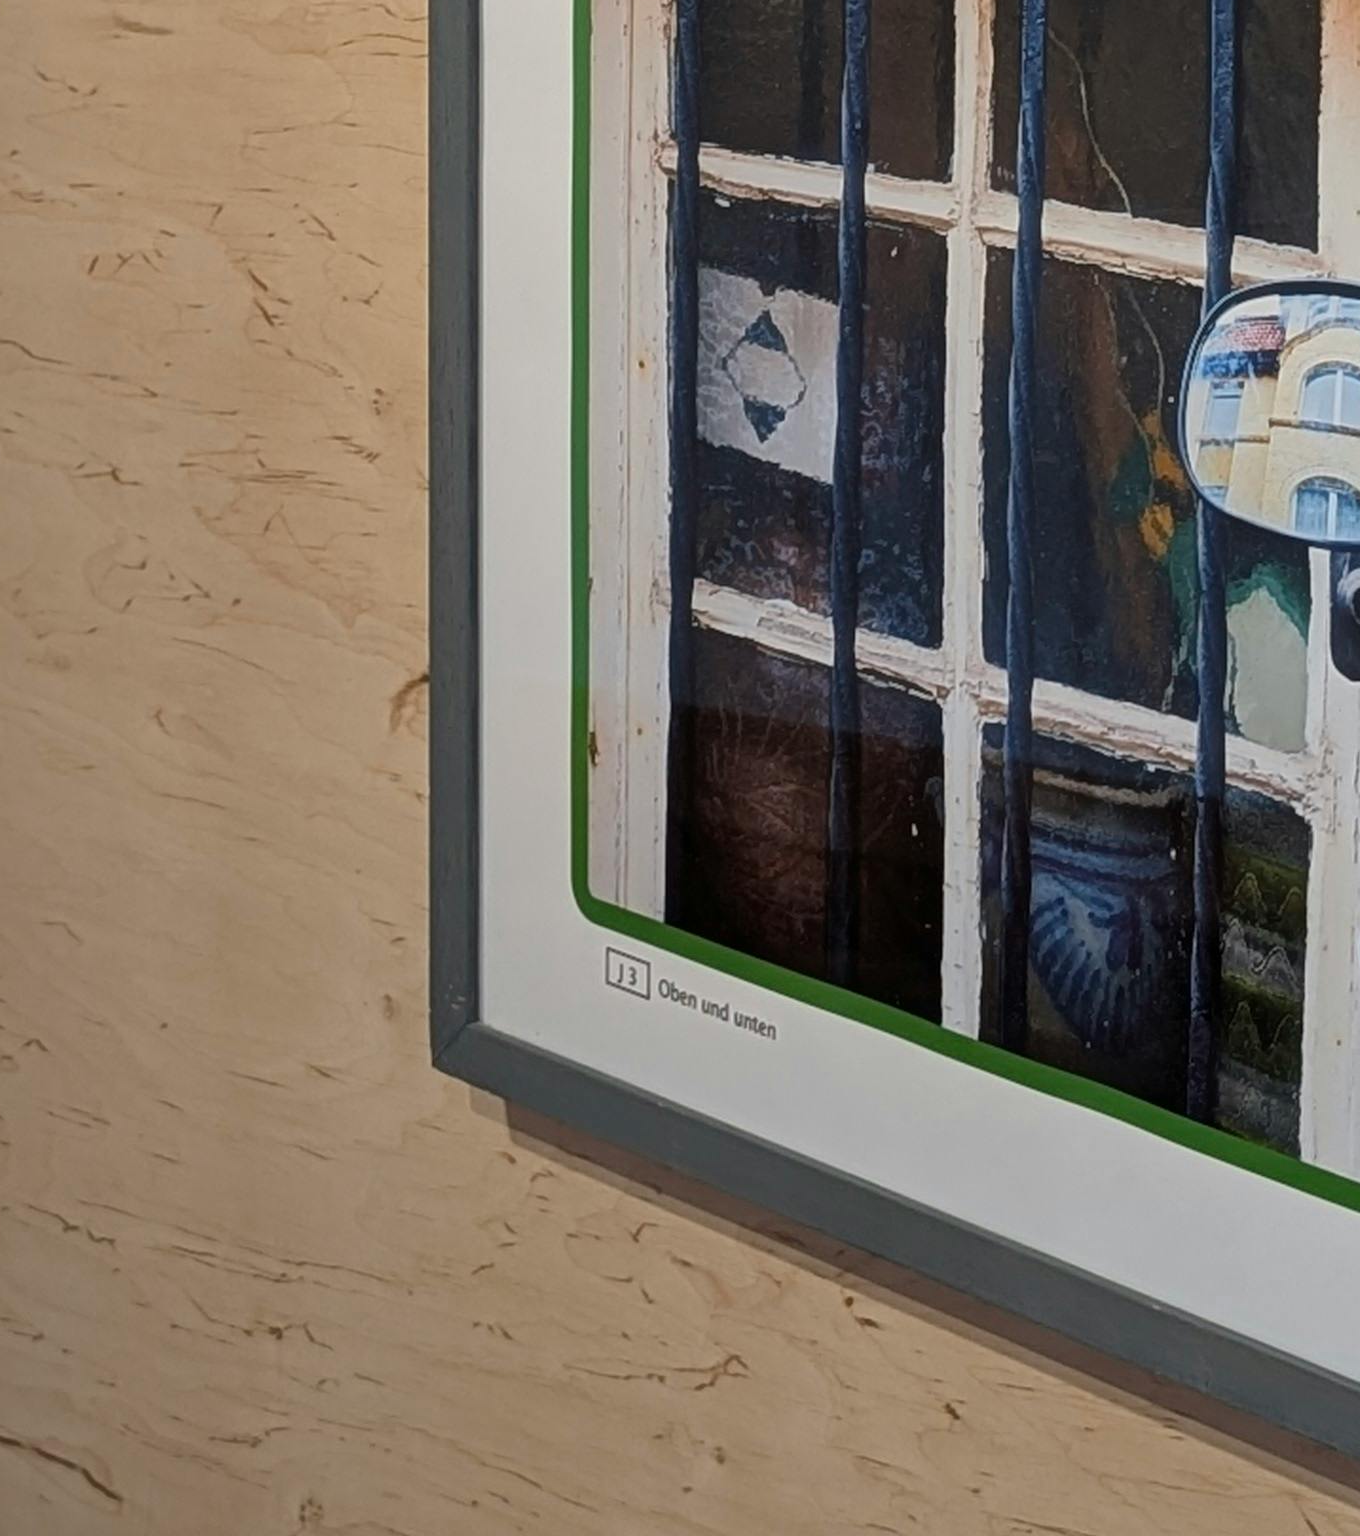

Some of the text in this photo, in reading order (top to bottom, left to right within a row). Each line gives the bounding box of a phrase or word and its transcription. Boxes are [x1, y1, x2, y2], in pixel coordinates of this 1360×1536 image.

[658, 978, 697, 1009] Oben
[701, 999, 729, 1021] und
[734, 1011, 776, 1040] unten
